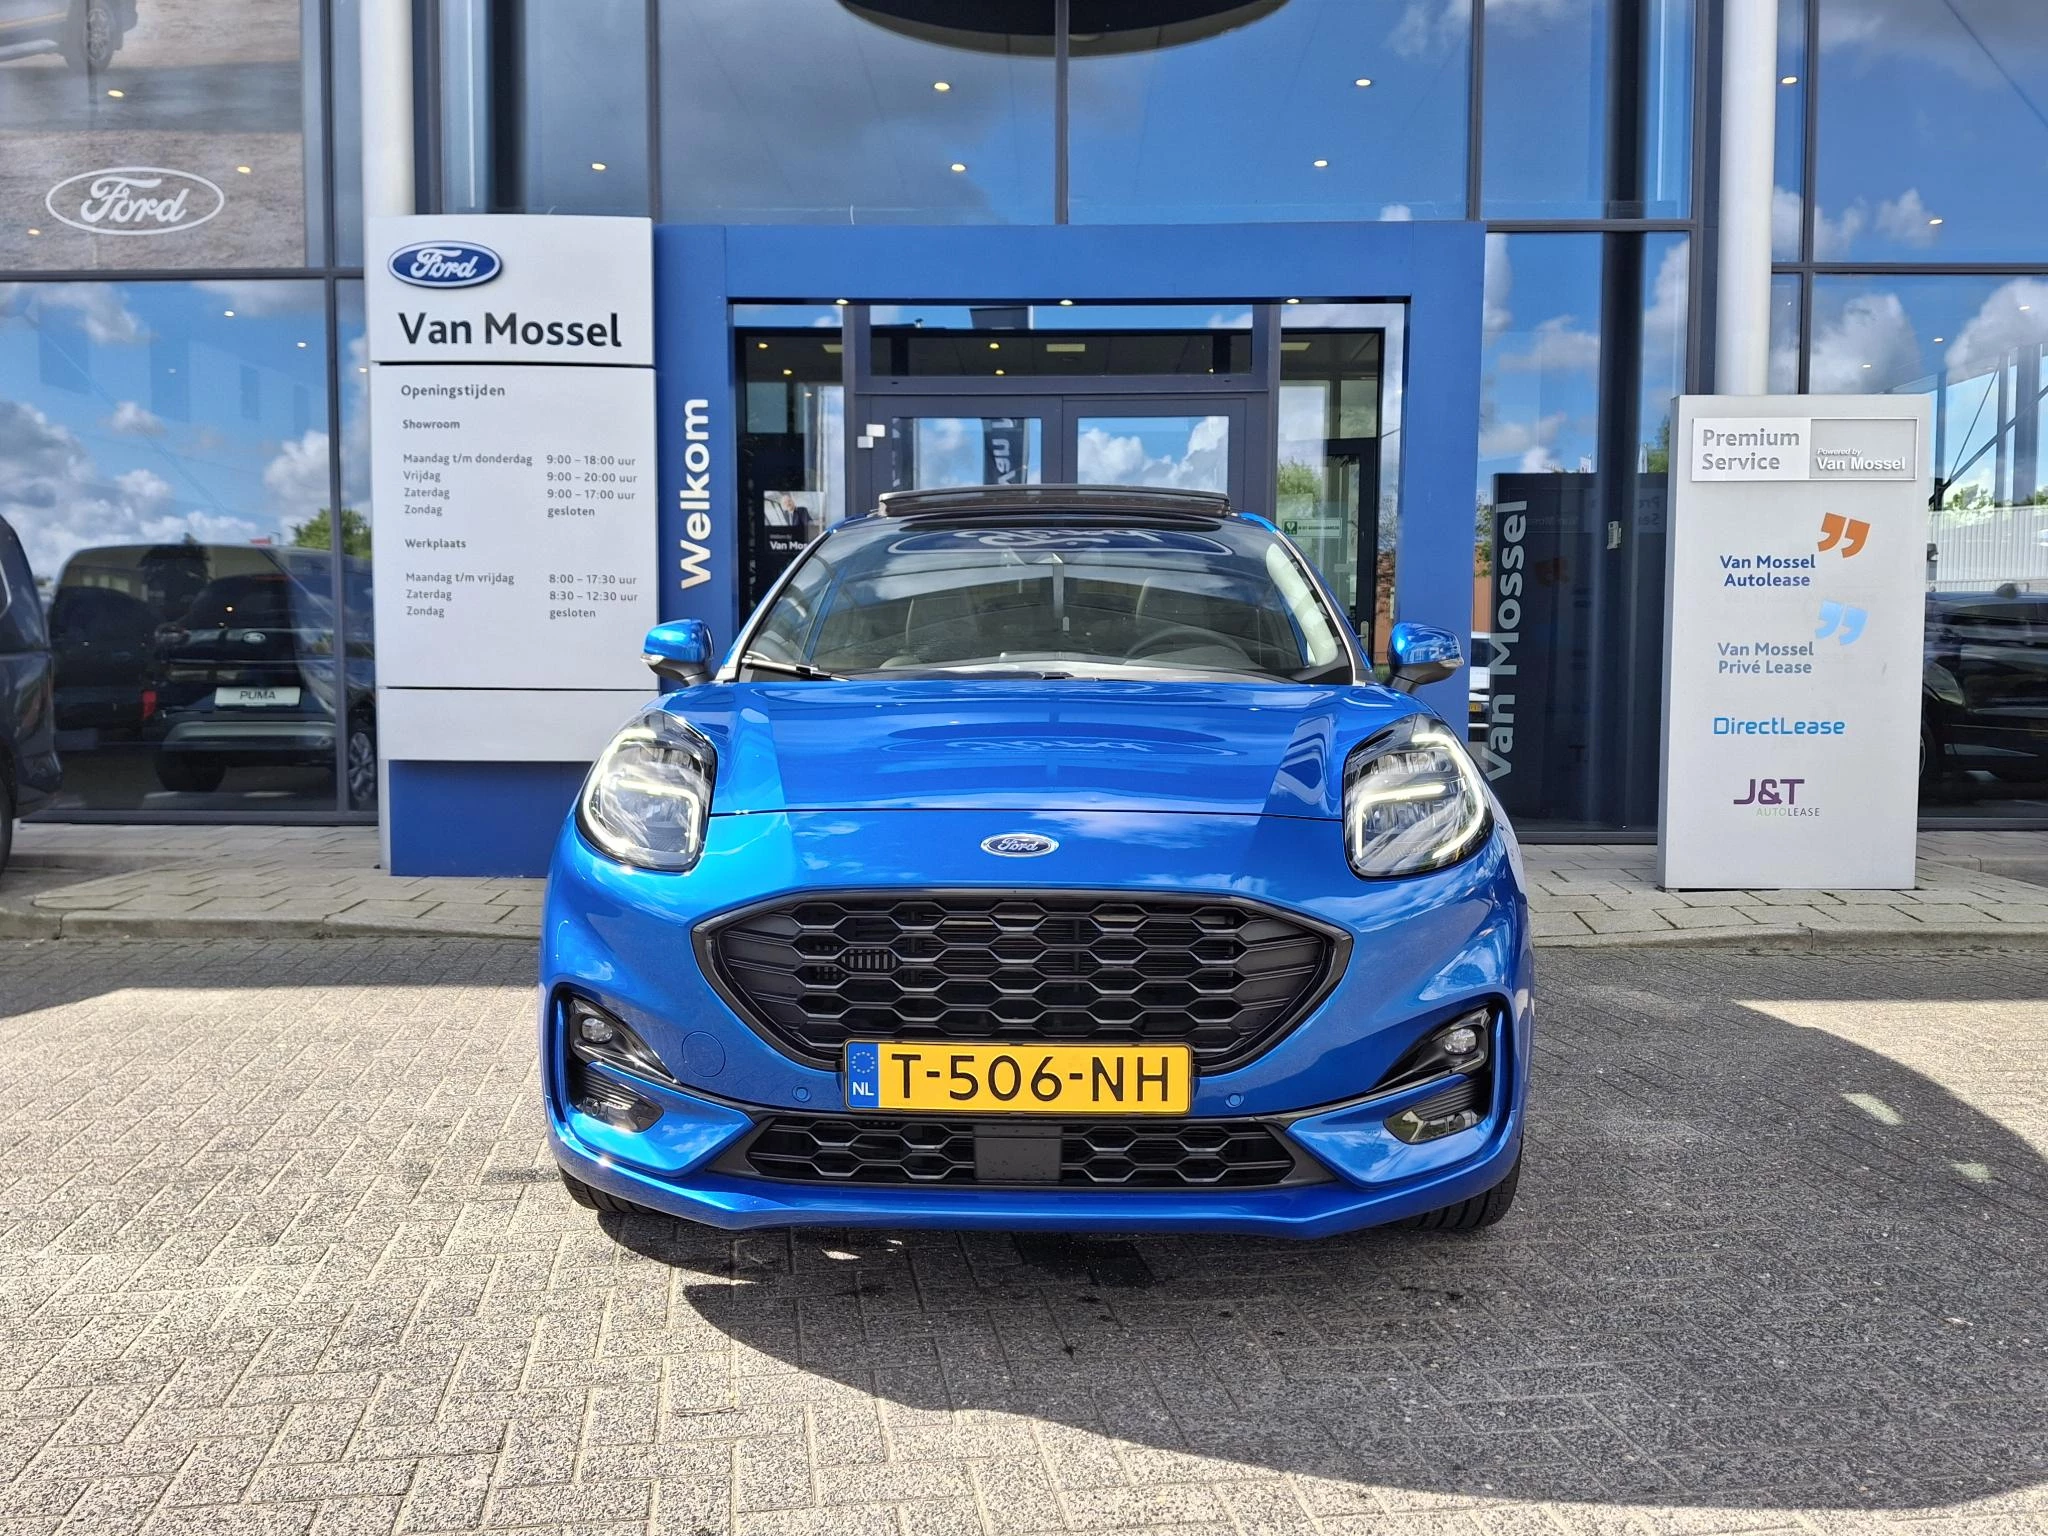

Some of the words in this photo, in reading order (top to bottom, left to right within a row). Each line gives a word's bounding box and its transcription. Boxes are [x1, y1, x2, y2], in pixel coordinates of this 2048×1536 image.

[80, 176, 190, 223] Ford
[410, 248, 479, 279] Ford
[398, 312, 472, 345] Van
[485, 312, 622, 347] Mossel
[401, 384, 505, 399] Openingstijden
[403, 418, 460, 430] Showroom
[1702, 428, 1800, 446] Premium
[403, 453, 450, 466] Maandag
[452, 453, 472, 464] t/m
[475, 453, 533, 466] donderdag
[547, 454, 571, 465] 9:00
[584, 455, 615, 465] 18:00
[618, 458, 635, 466] uur
[1817, 447, 1851, 456] Powered
[1852, 448, 1862, 458] by
[1702, 452, 1781, 471] Service
[1817, 457, 1846, 470] Van
[1851, 456, 1906, 471] Mossel
[403, 470, 441, 483] Vrijdag
[547, 471, 571, 482] 9:00
[584, 472, 616, 482] 20:00
[619, 475, 638, 483] uur
[404, 487, 450, 500] Zaterdag
[547, 488, 572, 499] 9:00
[584, 489, 615, 500] 17:00
[617, 492, 636, 500] uur
[680, 399, 712, 589] Welkom
[404, 504, 443, 517] Zondag
[547, 505, 596, 518] gesloten
[405, 537, 467, 550] Werkplaats
[769, 541, 788, 550] Van
[1720, 555, 1751, 568] Van
[1757, 554, 1816, 568] Mossel
[406, 572, 452, 585] Maandag
[455, 572, 475, 584] t/m
[478, 572, 515, 585] vrijdag
[549, 573, 574, 584] 8:00
[586, 574, 616, 585] 17:30
[619, 577, 637, 585] uur
[1724, 572, 1811, 587] Autolease
[1488, 500, 1528, 675] Mossel
[406, 589, 452, 602] Zaterdag
[550, 590, 574, 601] 8:30
[586, 591, 617, 601] 12:30
[407, 606, 445, 618] Zondag
[550, 608, 597, 620] gesloten
[1718, 642, 1749, 656] Van
[1755, 641, 1814, 656] Mossel
[1718, 660, 1760, 674] Privé
[1766, 660, 1812, 674] Lease
[240, 690, 276, 700] PUMA
[1713, 717, 1846, 735] DirectLease
[1481, 694, 1515, 781] Van
[1733, 779, 1805, 805] J&T
[1756, 807, 1821, 817] AUTOLEASE
[891, 1053, 1169, 1102] T-506-NH
[852, 1081, 875, 1097] NL
